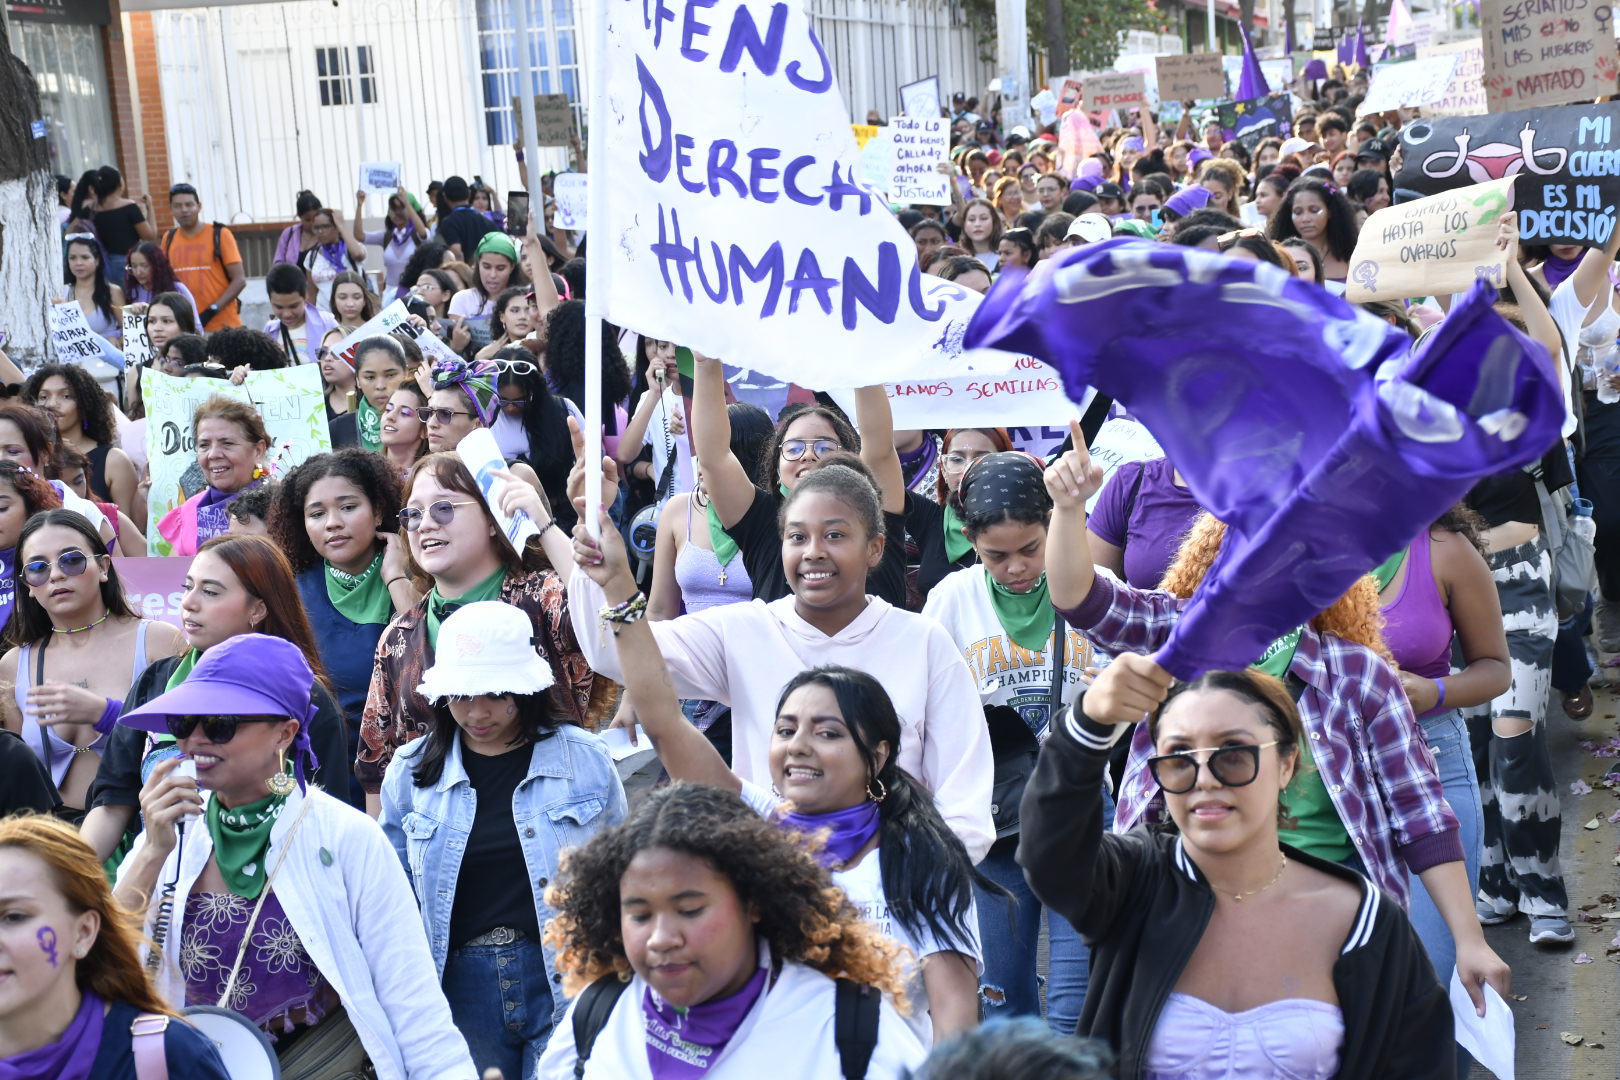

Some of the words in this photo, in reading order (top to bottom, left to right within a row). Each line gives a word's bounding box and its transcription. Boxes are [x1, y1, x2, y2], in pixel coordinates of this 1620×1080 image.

[1504, 48, 1534, 68] LAS
[1516, 67, 1586, 100] MATADO
[1578, 115, 1612, 145] MI
[1543, 184, 1568, 208] ES
[1575, 184, 1602, 210] MI
[1382, 220, 1424, 244] HASTA
[1444, 211, 1469, 234] LOS
[1400, 238, 1457, 264] OVARIOS
